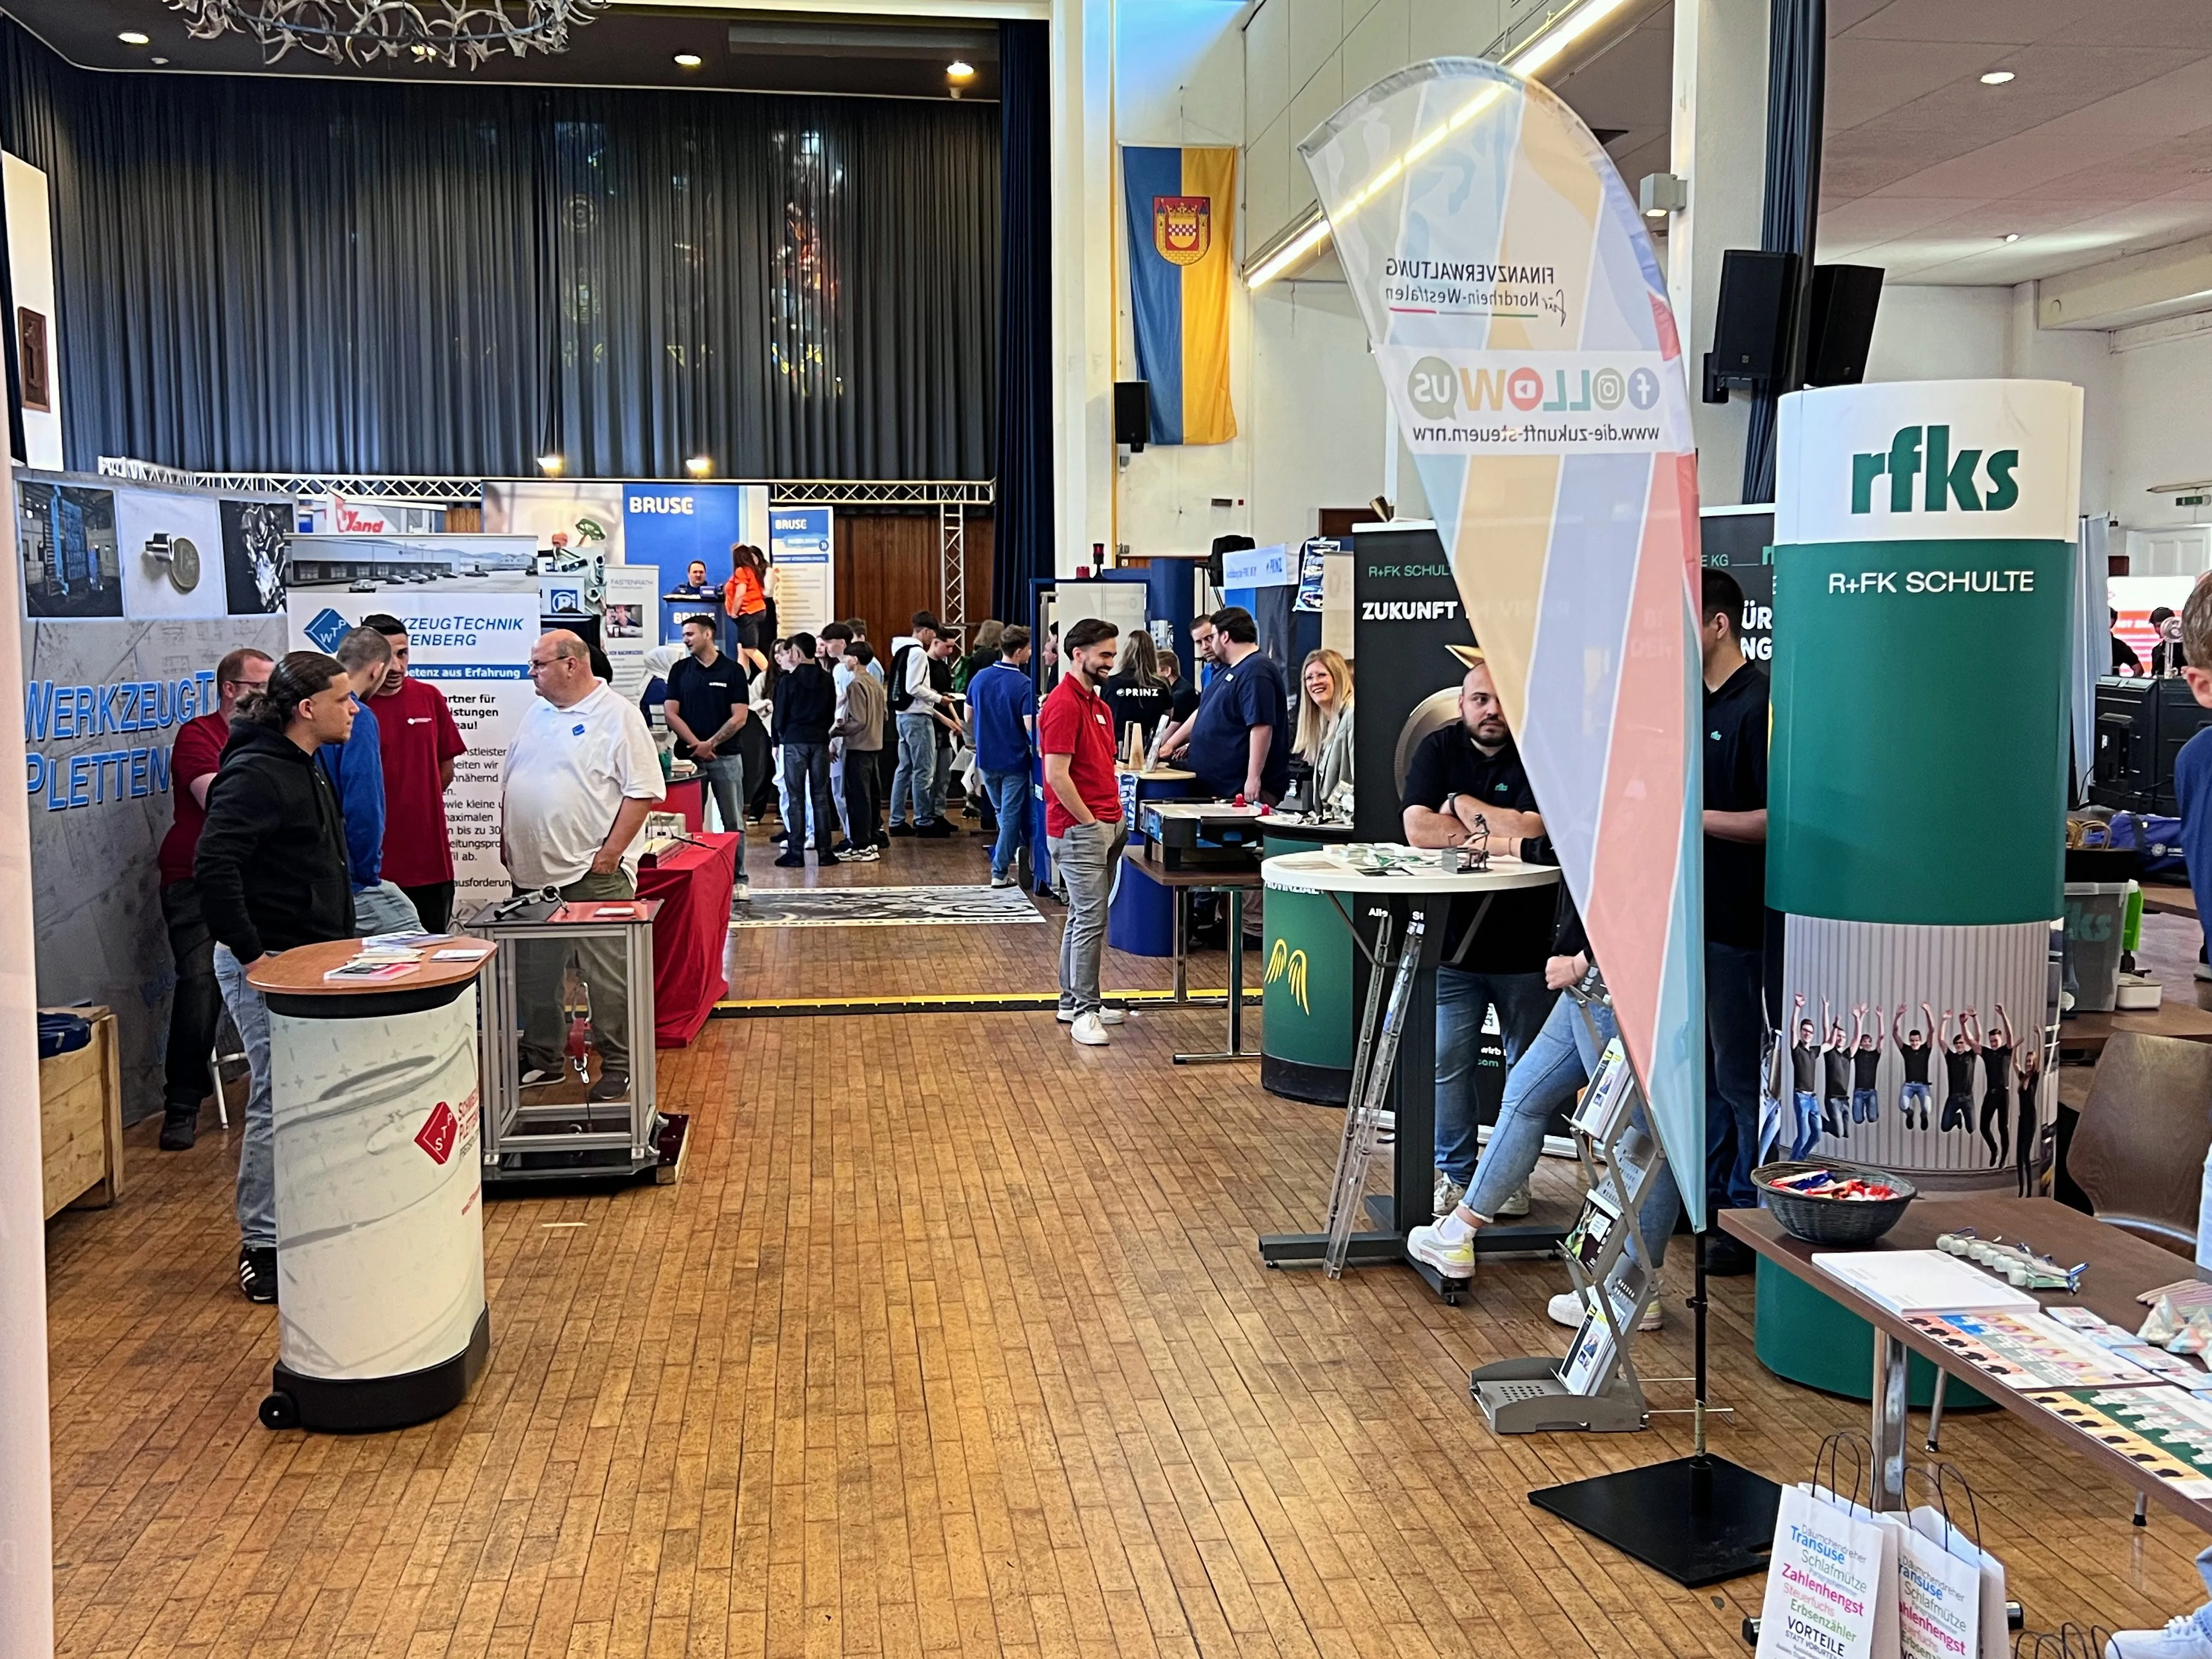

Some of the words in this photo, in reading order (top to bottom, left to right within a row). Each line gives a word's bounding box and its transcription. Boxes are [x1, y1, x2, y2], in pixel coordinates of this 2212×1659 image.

[1851, 425, 2019, 515] rfks
[630, 496, 694, 515] BRUSE
[775, 518, 808, 531] BRUSE
[1711, 554, 1729, 567] KG
[1368, 566, 1400, 578] R+FK
[1404, 565, 1453, 577] SCHUL
[1829, 572, 1897, 594] R+FK
[1905, 570, 2035, 593] SCHULTE
[1362, 601, 1458, 620] ZUKUNFT
[408, 634, 477, 646] ENBERG
[406, 668, 439, 678] etenz
[442, 669, 462, 678] aus
[465, 668, 521, 680] Erfahrung
[479, 695, 496, 703] für
[1125, 688, 1159, 697] PRINZ
[25, 669, 219, 742] WERKZEUGT
[483, 760, 499, 769] wir
[26, 744, 174, 811] PLETTEN
[466, 799, 495, 809] kleine
[457, 826, 471, 834] bis
[462, 852, 478, 861] ab.
[454, 877, 512, 887] ausforderun
[1791, 1525, 1845, 1565] Transuse
[1801, 1549, 1867, 1593] Schlafmütze
[1898, 1559, 1943, 1601] ransuse
[1782, 1562, 1864, 1617] Zahlenhengst
[1783, 1583, 1835, 1617] Steuerfuchs
[1904, 1581, 1967, 1632] Schlafmütze
[1790, 1598, 1857, 1643] Erbsenzähler
[1899, 1601, 1966, 1656] ahlenhengst
[1787, 1615, 1846, 1657] VORTEILE
[1805, 1640, 1842, 1659] VORURTEI
